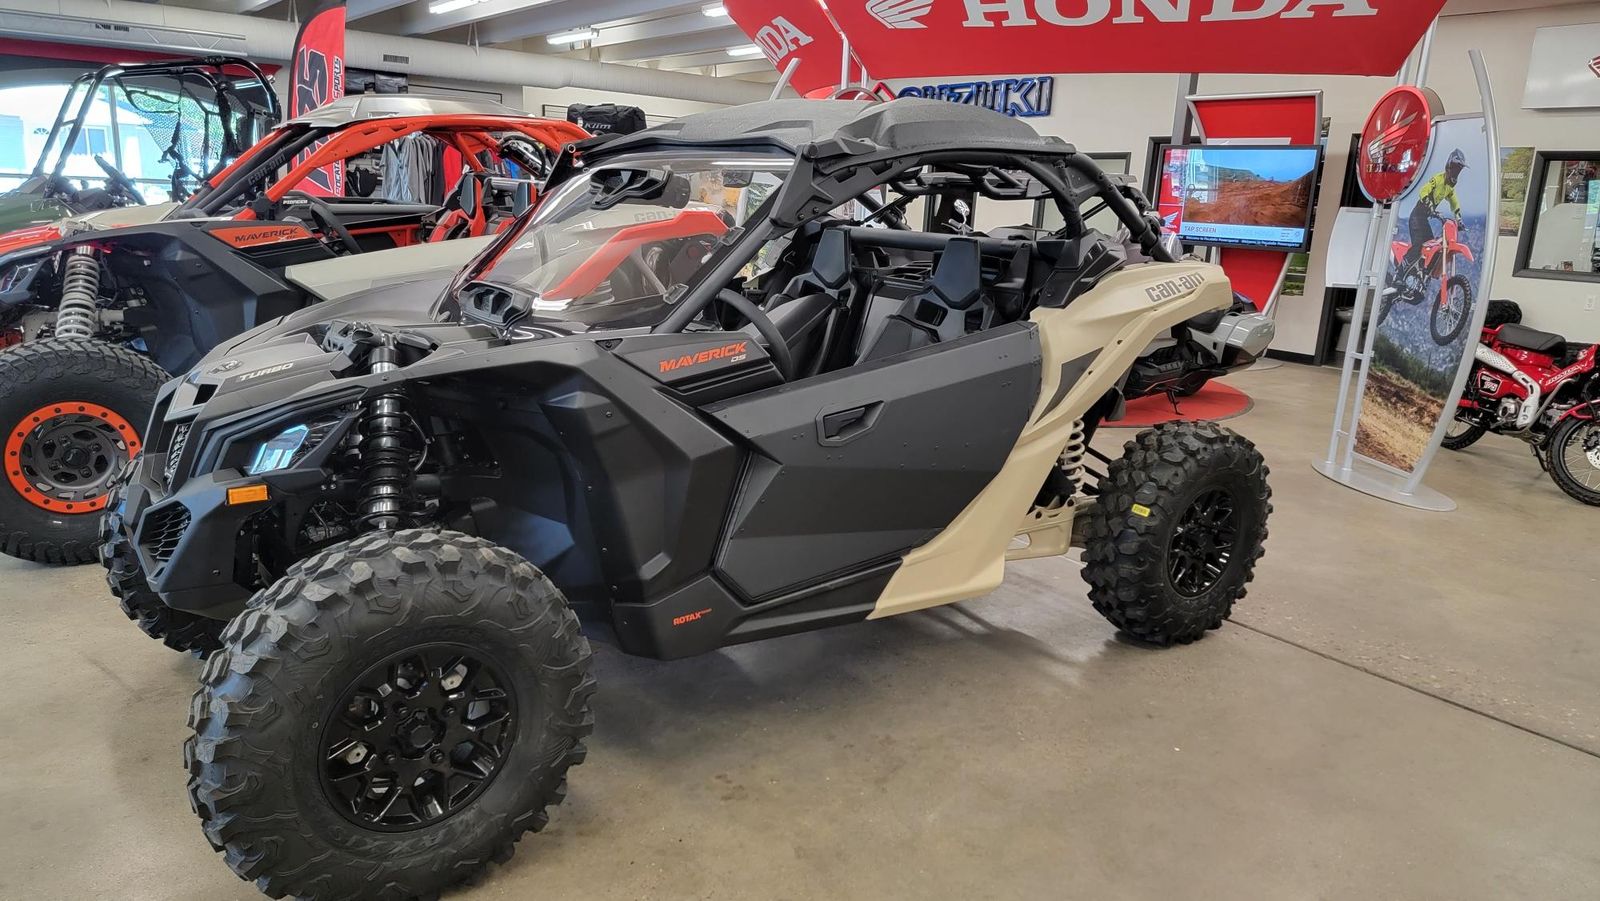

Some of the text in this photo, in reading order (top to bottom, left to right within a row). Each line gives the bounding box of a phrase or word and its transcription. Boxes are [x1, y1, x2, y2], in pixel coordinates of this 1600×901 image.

[897, 76, 1054, 118] ZUKI
[234, 227, 298, 243] MAVERICK
[1195, 226, 1217, 234] SCREEN
[1144, 271, 1205, 303] can-am
[659, 341, 748, 373] MAVERICK
[730, 353, 747, 363] DS
[239, 362, 294, 381] TURBO
[673, 611, 702, 626] ROTAX
